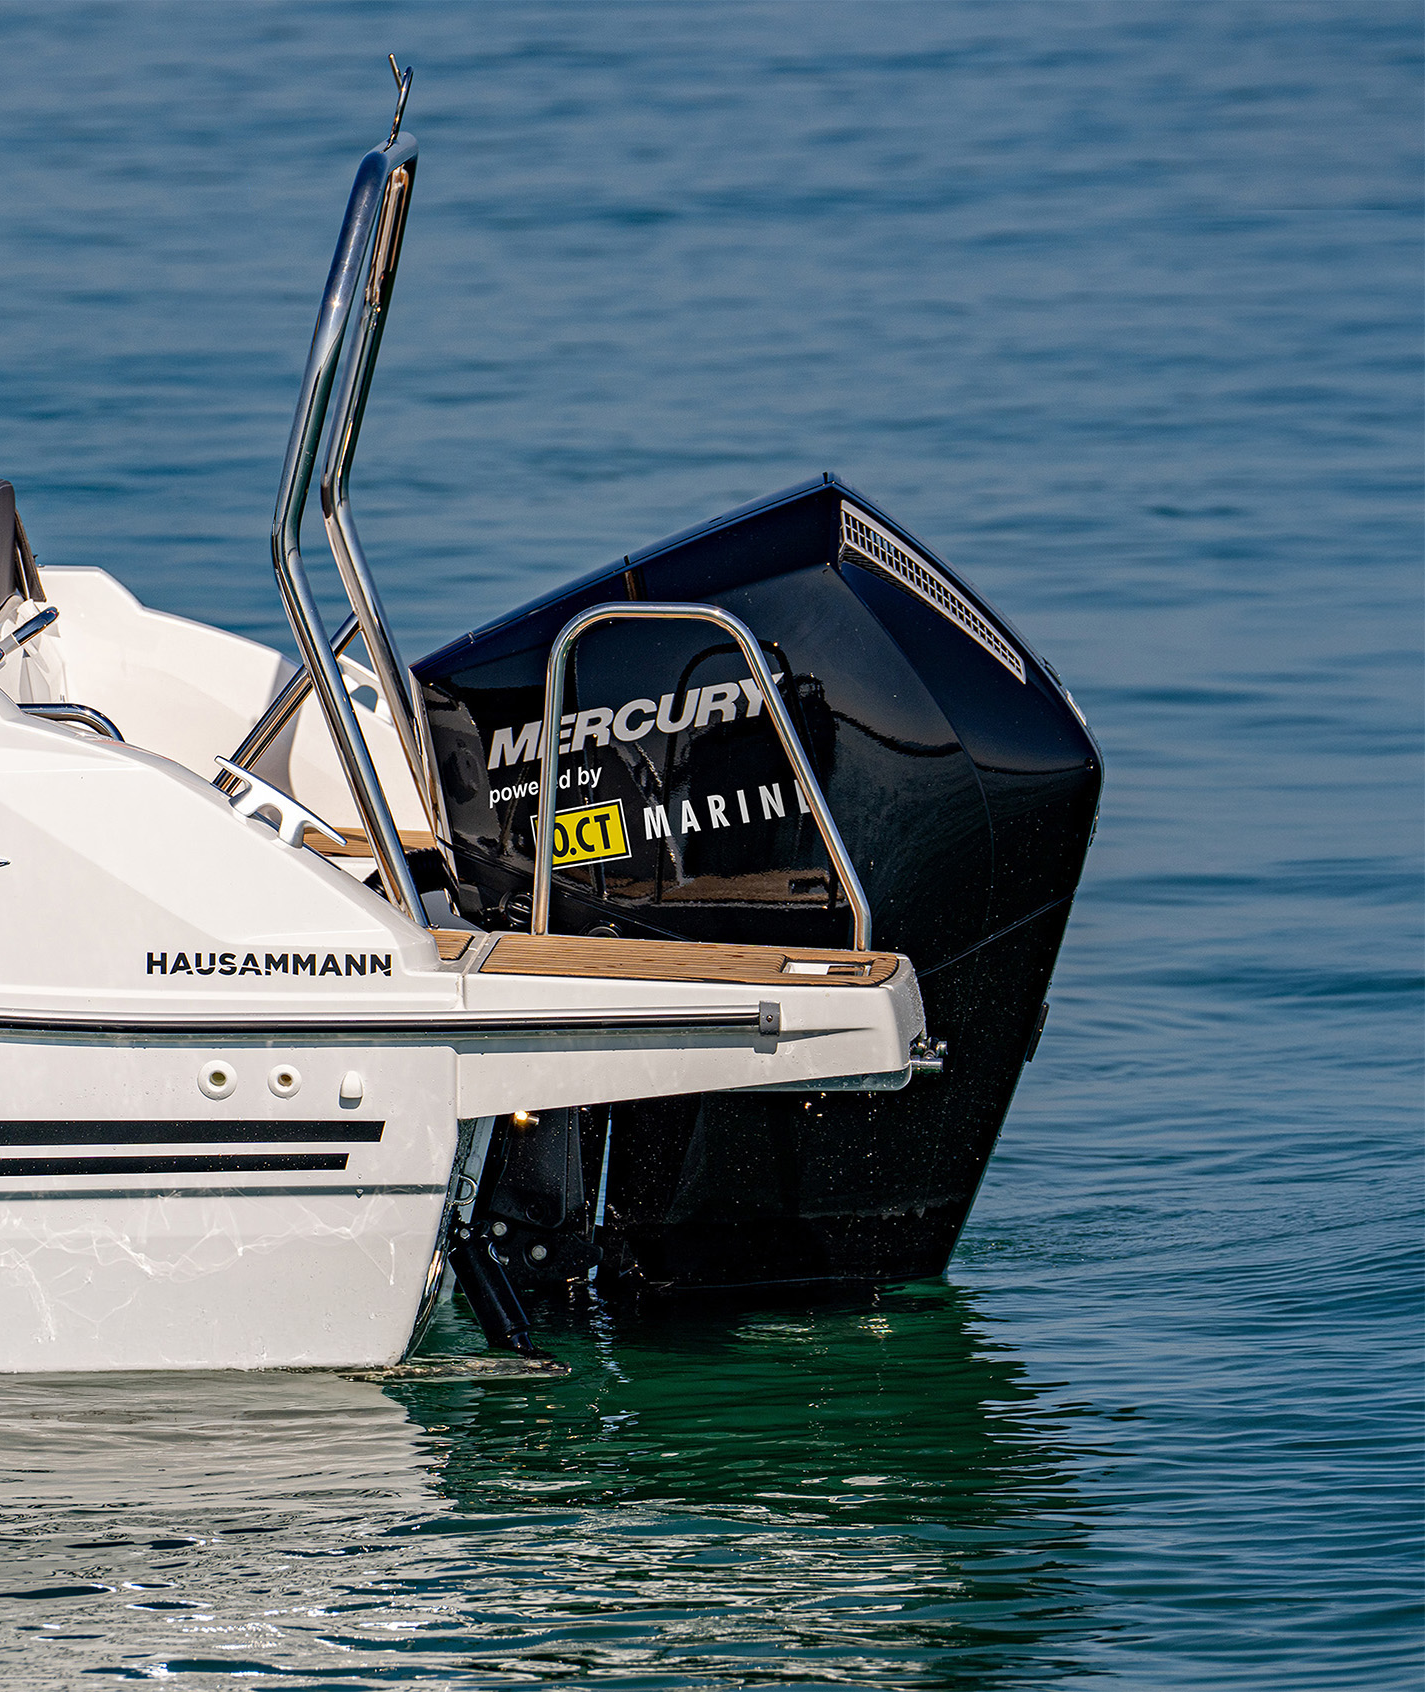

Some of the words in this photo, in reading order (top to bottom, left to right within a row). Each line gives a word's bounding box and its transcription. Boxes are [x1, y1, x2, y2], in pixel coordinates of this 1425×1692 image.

[487, 671, 784, 770] MERCURY
[489, 769, 571, 809] powed
[578, 766, 602, 789] by
[146, 951, 392, 977] HAUSAMMANN
